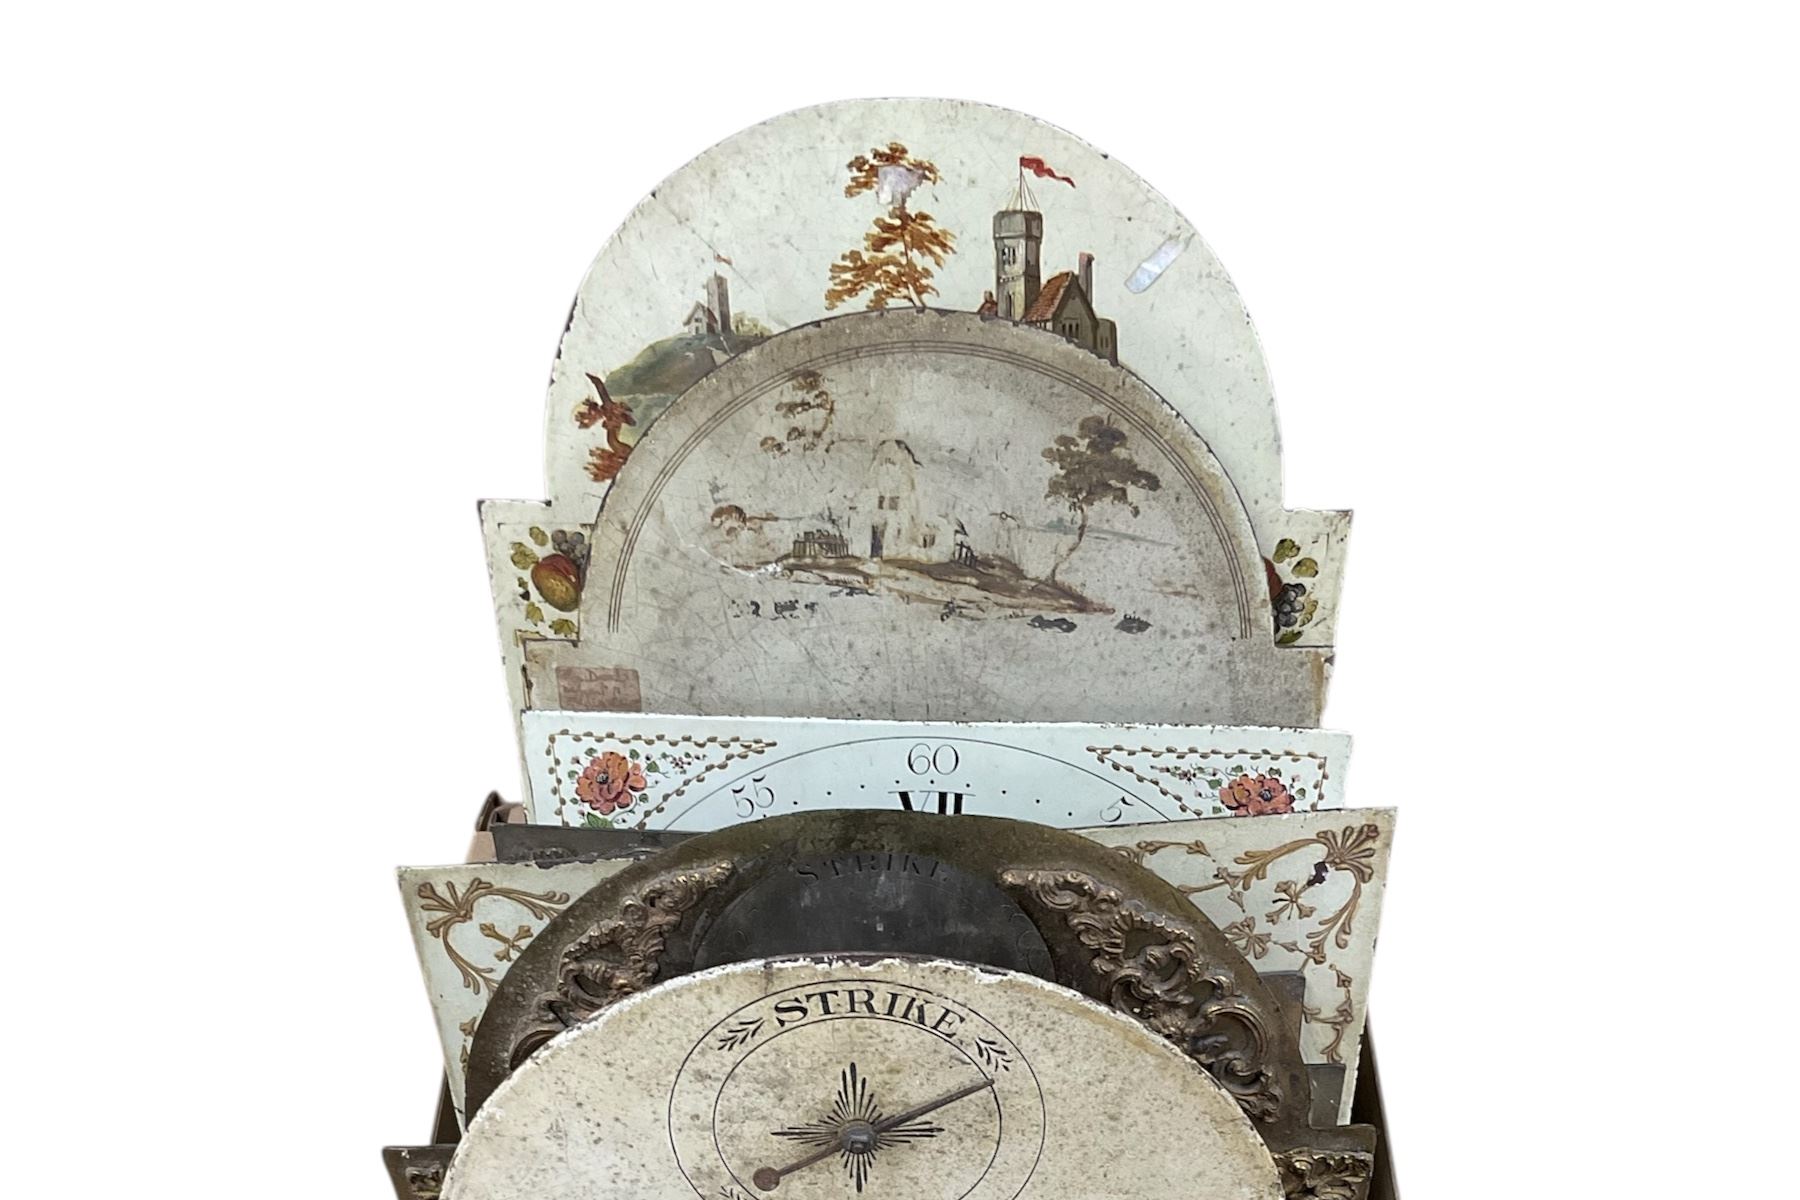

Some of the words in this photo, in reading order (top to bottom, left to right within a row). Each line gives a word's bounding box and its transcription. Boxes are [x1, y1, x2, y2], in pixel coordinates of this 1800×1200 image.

[907, 743, 959, 775] 60
[731, 774, 775, 818] 55
[1100, 795, 1135, 822] 5
